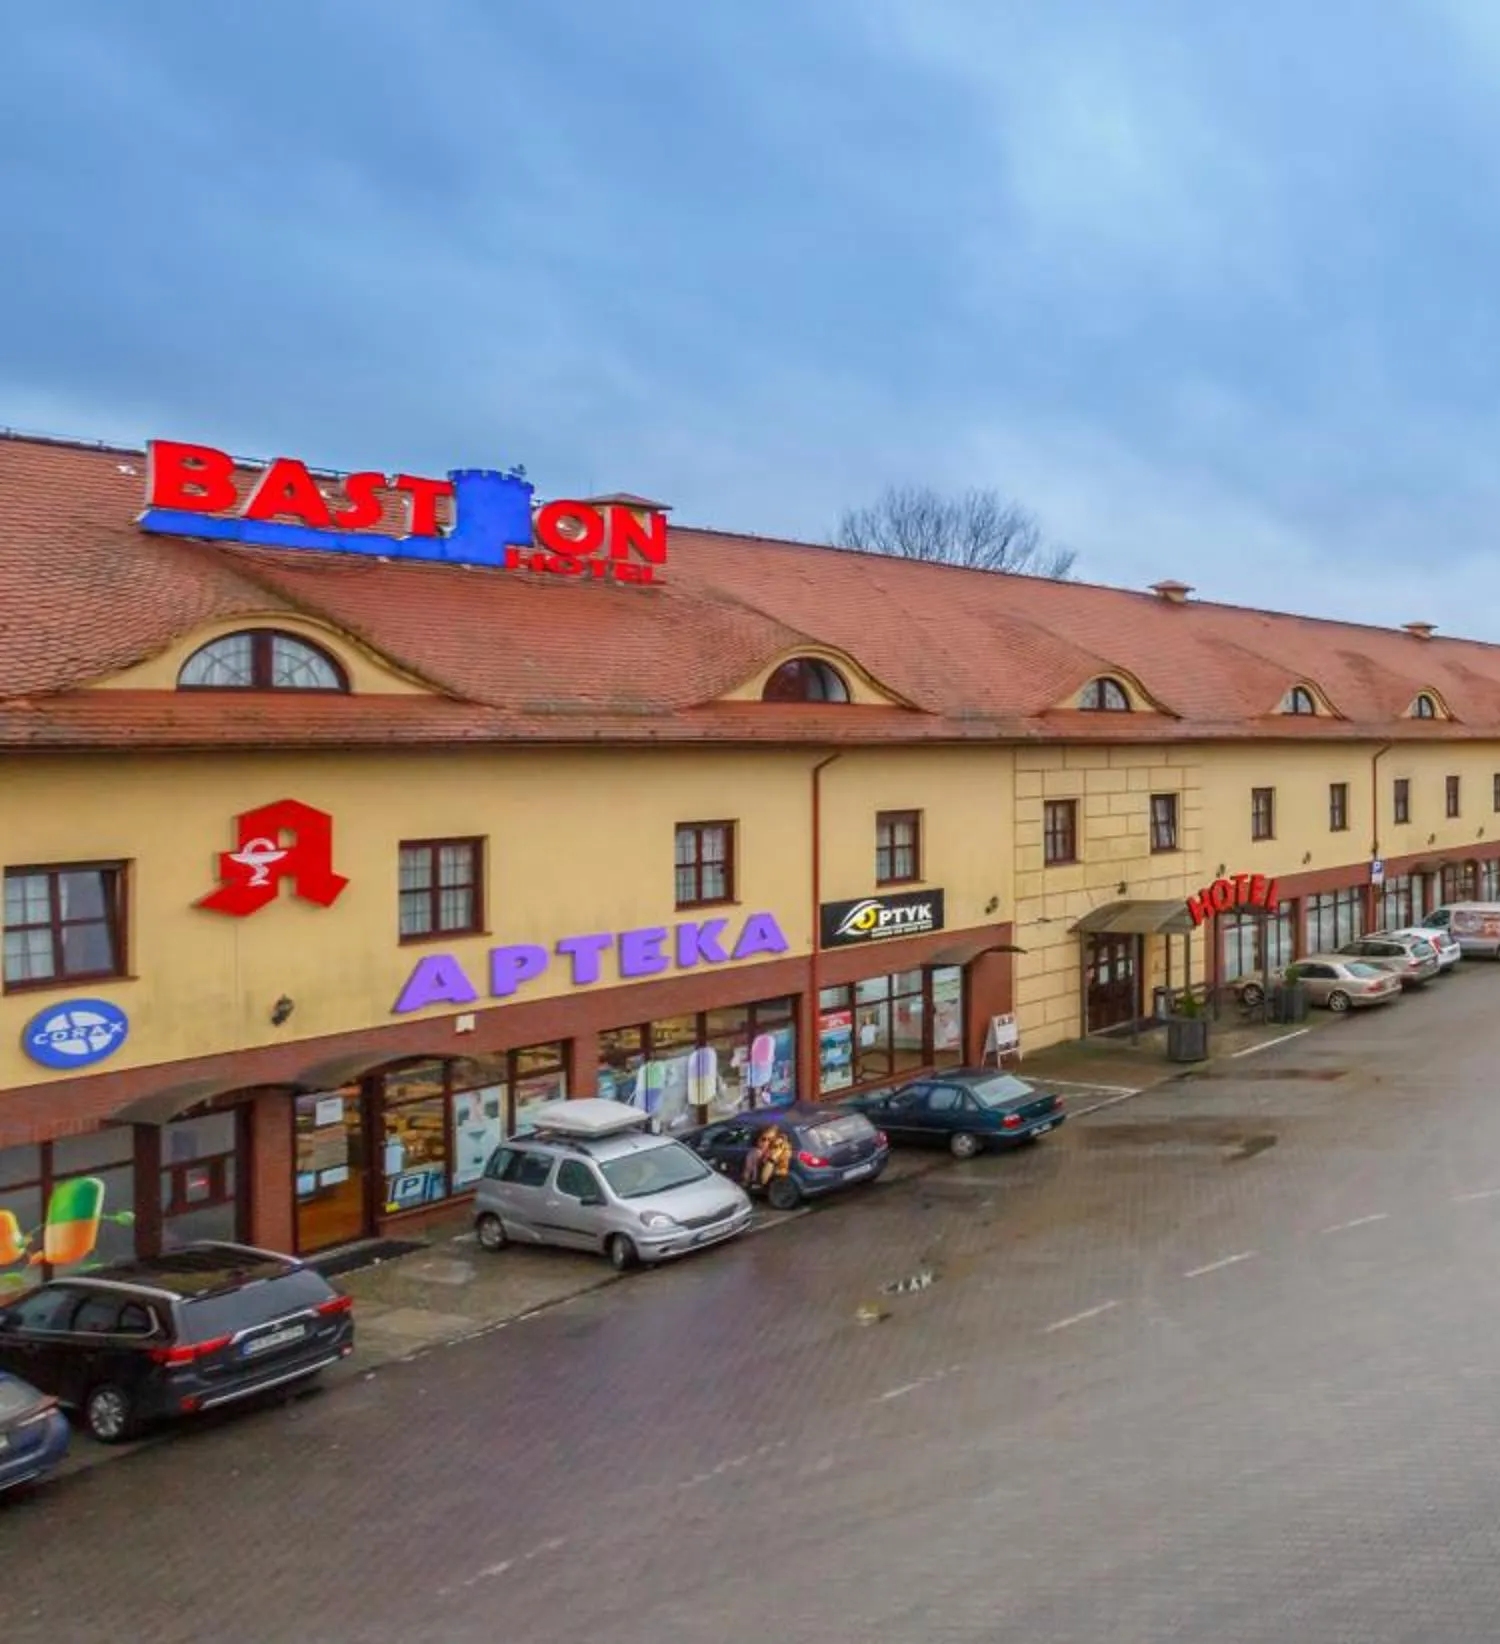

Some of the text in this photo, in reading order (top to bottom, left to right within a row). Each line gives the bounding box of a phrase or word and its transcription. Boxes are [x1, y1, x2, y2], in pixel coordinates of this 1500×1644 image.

[504, 547, 668, 586] HOTEL
[1186, 873, 1279, 926] HOTEL
[391, 912, 790, 1014] APTEKA
[32, 1021, 124, 1045] CORAX
